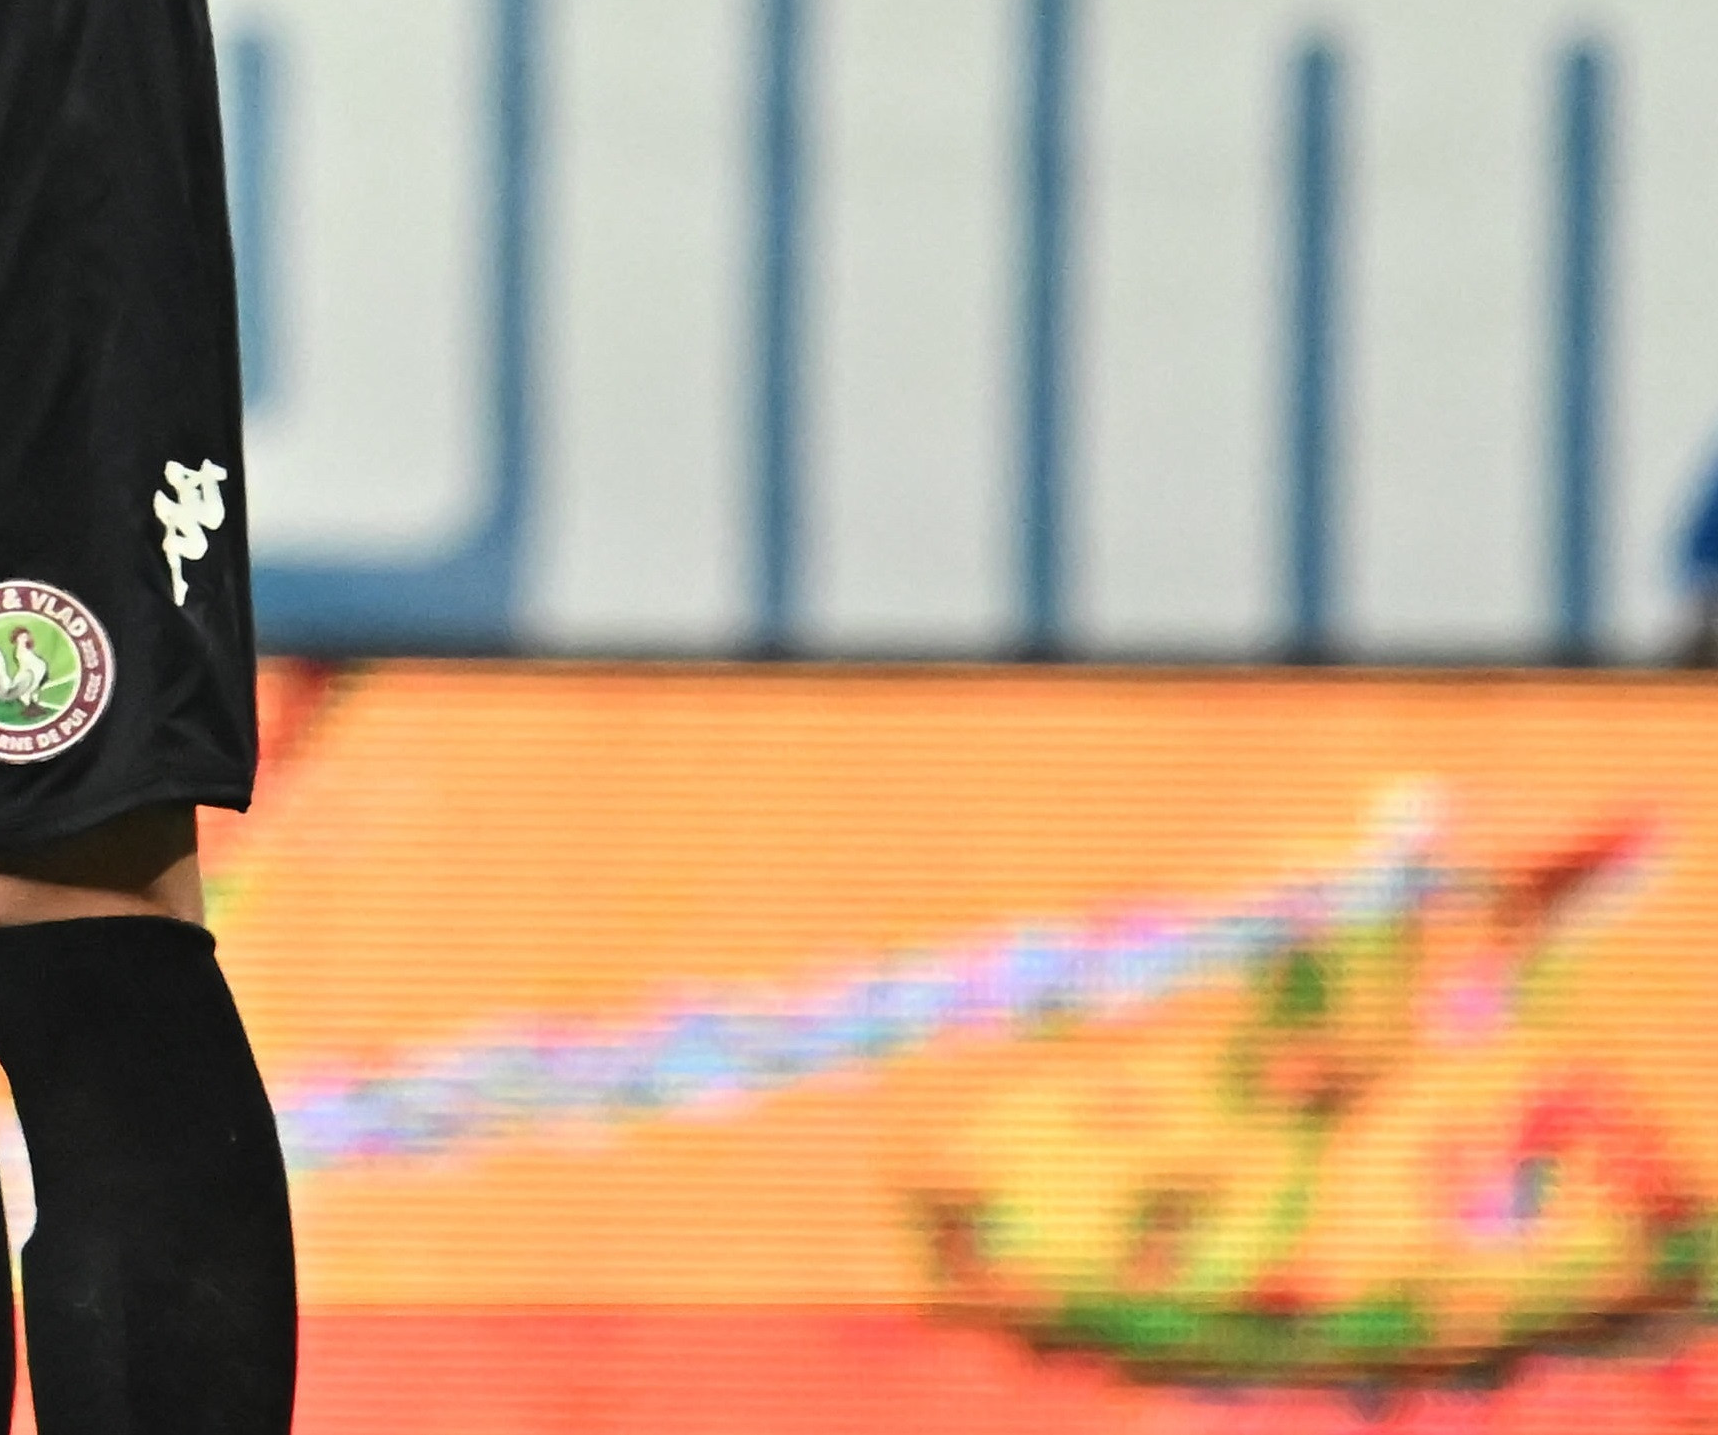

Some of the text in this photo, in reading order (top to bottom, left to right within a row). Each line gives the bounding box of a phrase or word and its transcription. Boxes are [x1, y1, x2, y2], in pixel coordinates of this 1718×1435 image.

[2, 588, 23, 609] &
[29, 590, 88, 637] VLAD
[35, 729, 62, 749] DE
